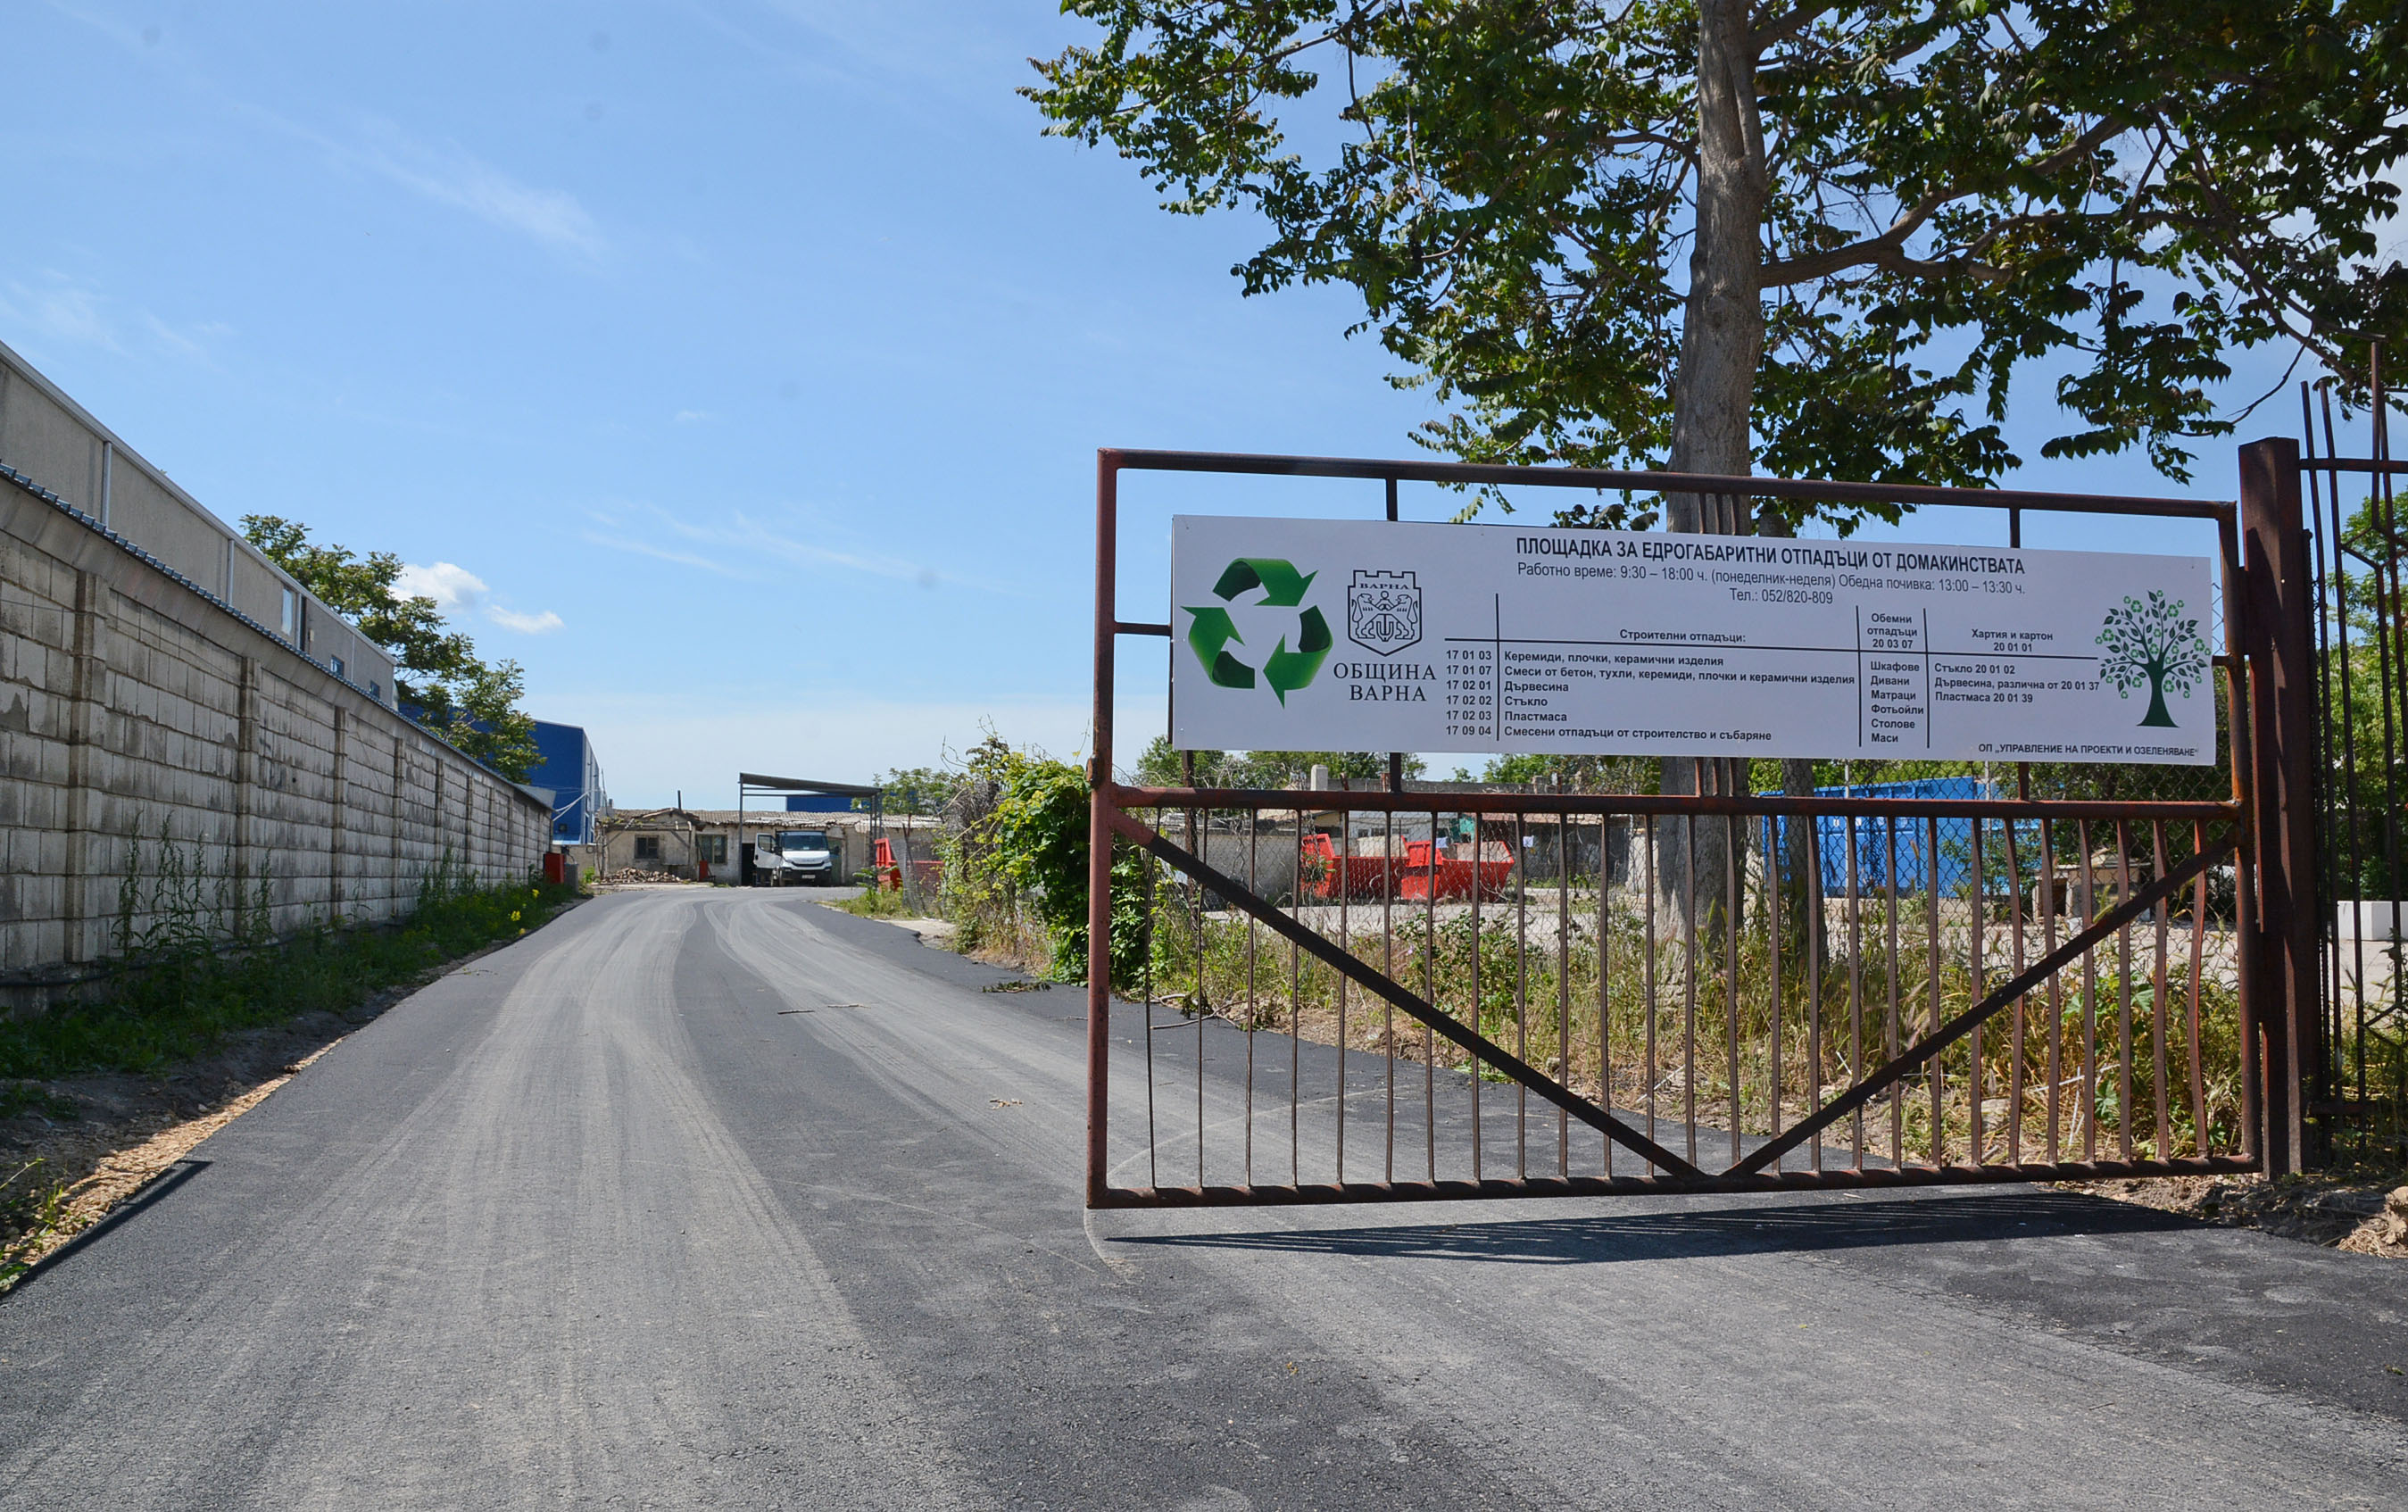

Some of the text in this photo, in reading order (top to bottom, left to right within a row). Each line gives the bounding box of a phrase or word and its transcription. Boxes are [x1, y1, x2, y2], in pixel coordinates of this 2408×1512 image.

[1517, 537, 2026, 574] ПЛОЩАДКА ЗА ЕДРОГАБАРИТНИ ОТПАДЪЦИ ОТ ДОМАКИНСТВАТА
[1518, 562, 1570, 576] Работно
[1574, 566, 1617, 580] време:
[1620, 565, 1646, 579] 9:30
[1661, 566, 1694, 581] 18:00
[1697, 571, 1708, 582] ч.
[1711, 569, 1835, 590] (понеделник-неделя)
[1838, 573, 1883, 590] Обедна
[1886, 579, 1935, 590] почивка:
[1939, 579, 1968, 592] 13:00
[1983, 581, 2012, 594] 13:30
[2015, 585, 2025, 594] ч.
[1729, 588, 1833, 605] Тел.: 052/820-809
[1871, 613, 1912, 623] Обемни
[1619, 629, 1745, 643] Строителни отпадъци:
[1867, 628, 1918, 638] отпадъци
[1971, 629, 2008, 640] Хартия
[2019, 632, 2053, 642] картон
[1872, 639, 1913, 649] 20 03 07
[1993, 642, 2032, 652] 20 01 01
[1446, 649, 1492, 660] 17 01 03
[1504, 650, 1724, 667] Керемиди, плочки, керамични изделия
[1333, 663, 1437, 683] ОБЩИНА
[1446, 665, 1492, 675] 17 01 07
[1870, 661, 1919, 673] Шкафове
[1935, 663, 2016, 674] Стъкло 20 01 02
[1504, 665, 1542, 676] Смеси
[1561, 666, 1596, 679] бетон,
[1599, 670, 1636, 680] тухли,
[1638, 671, 1695, 681] керемиди,
[1698, 673, 1737, 681] плочки
[1740, 673, 1746, 681] и
[1750, 673, 1808, 684] керамични
[1810, 675, 1855, 685] изделия
[1870, 675, 1910, 687] Дивани
[1446, 680, 1491, 690] 17 02 01
[1503, 681, 1569, 693] Дървесина
[1935, 677, 1994, 690] Дървесина,
[1997, 681, 2045, 690] различна
[2060, 681, 2073, 690] 20
[2075, 681, 2085, 690] 01
[2088, 681, 2100, 690] 37
[1349, 684, 1427, 702] ВАРНА
[1871, 690, 1916, 702] Матраци
[1935, 691, 2033, 703] Пластмаса 20 01 39
[1446, 695, 1492, 706] 17 02 02
[1504, 696, 1548, 706] Стъкло
[1871, 704, 1924, 714] Фотьойли
[1446, 710, 1492, 721] 17 02 03
[1504, 711, 1567, 722] Пластмаса
[1871, 718, 1916, 729] Столове
[1445, 725, 1492, 736] 17 09 04
[1504, 726, 1771, 742] Смесени отпадъци от строителство и събаряне
[1871, 732, 1899, 743] Маси
[1978, 743, 1993, 752] ОП
[2065, 745, 2078, 754] НА
[2080, 745, 2124, 754] ПРОЕКТИ
[2126, 746, 2132, 755] И
